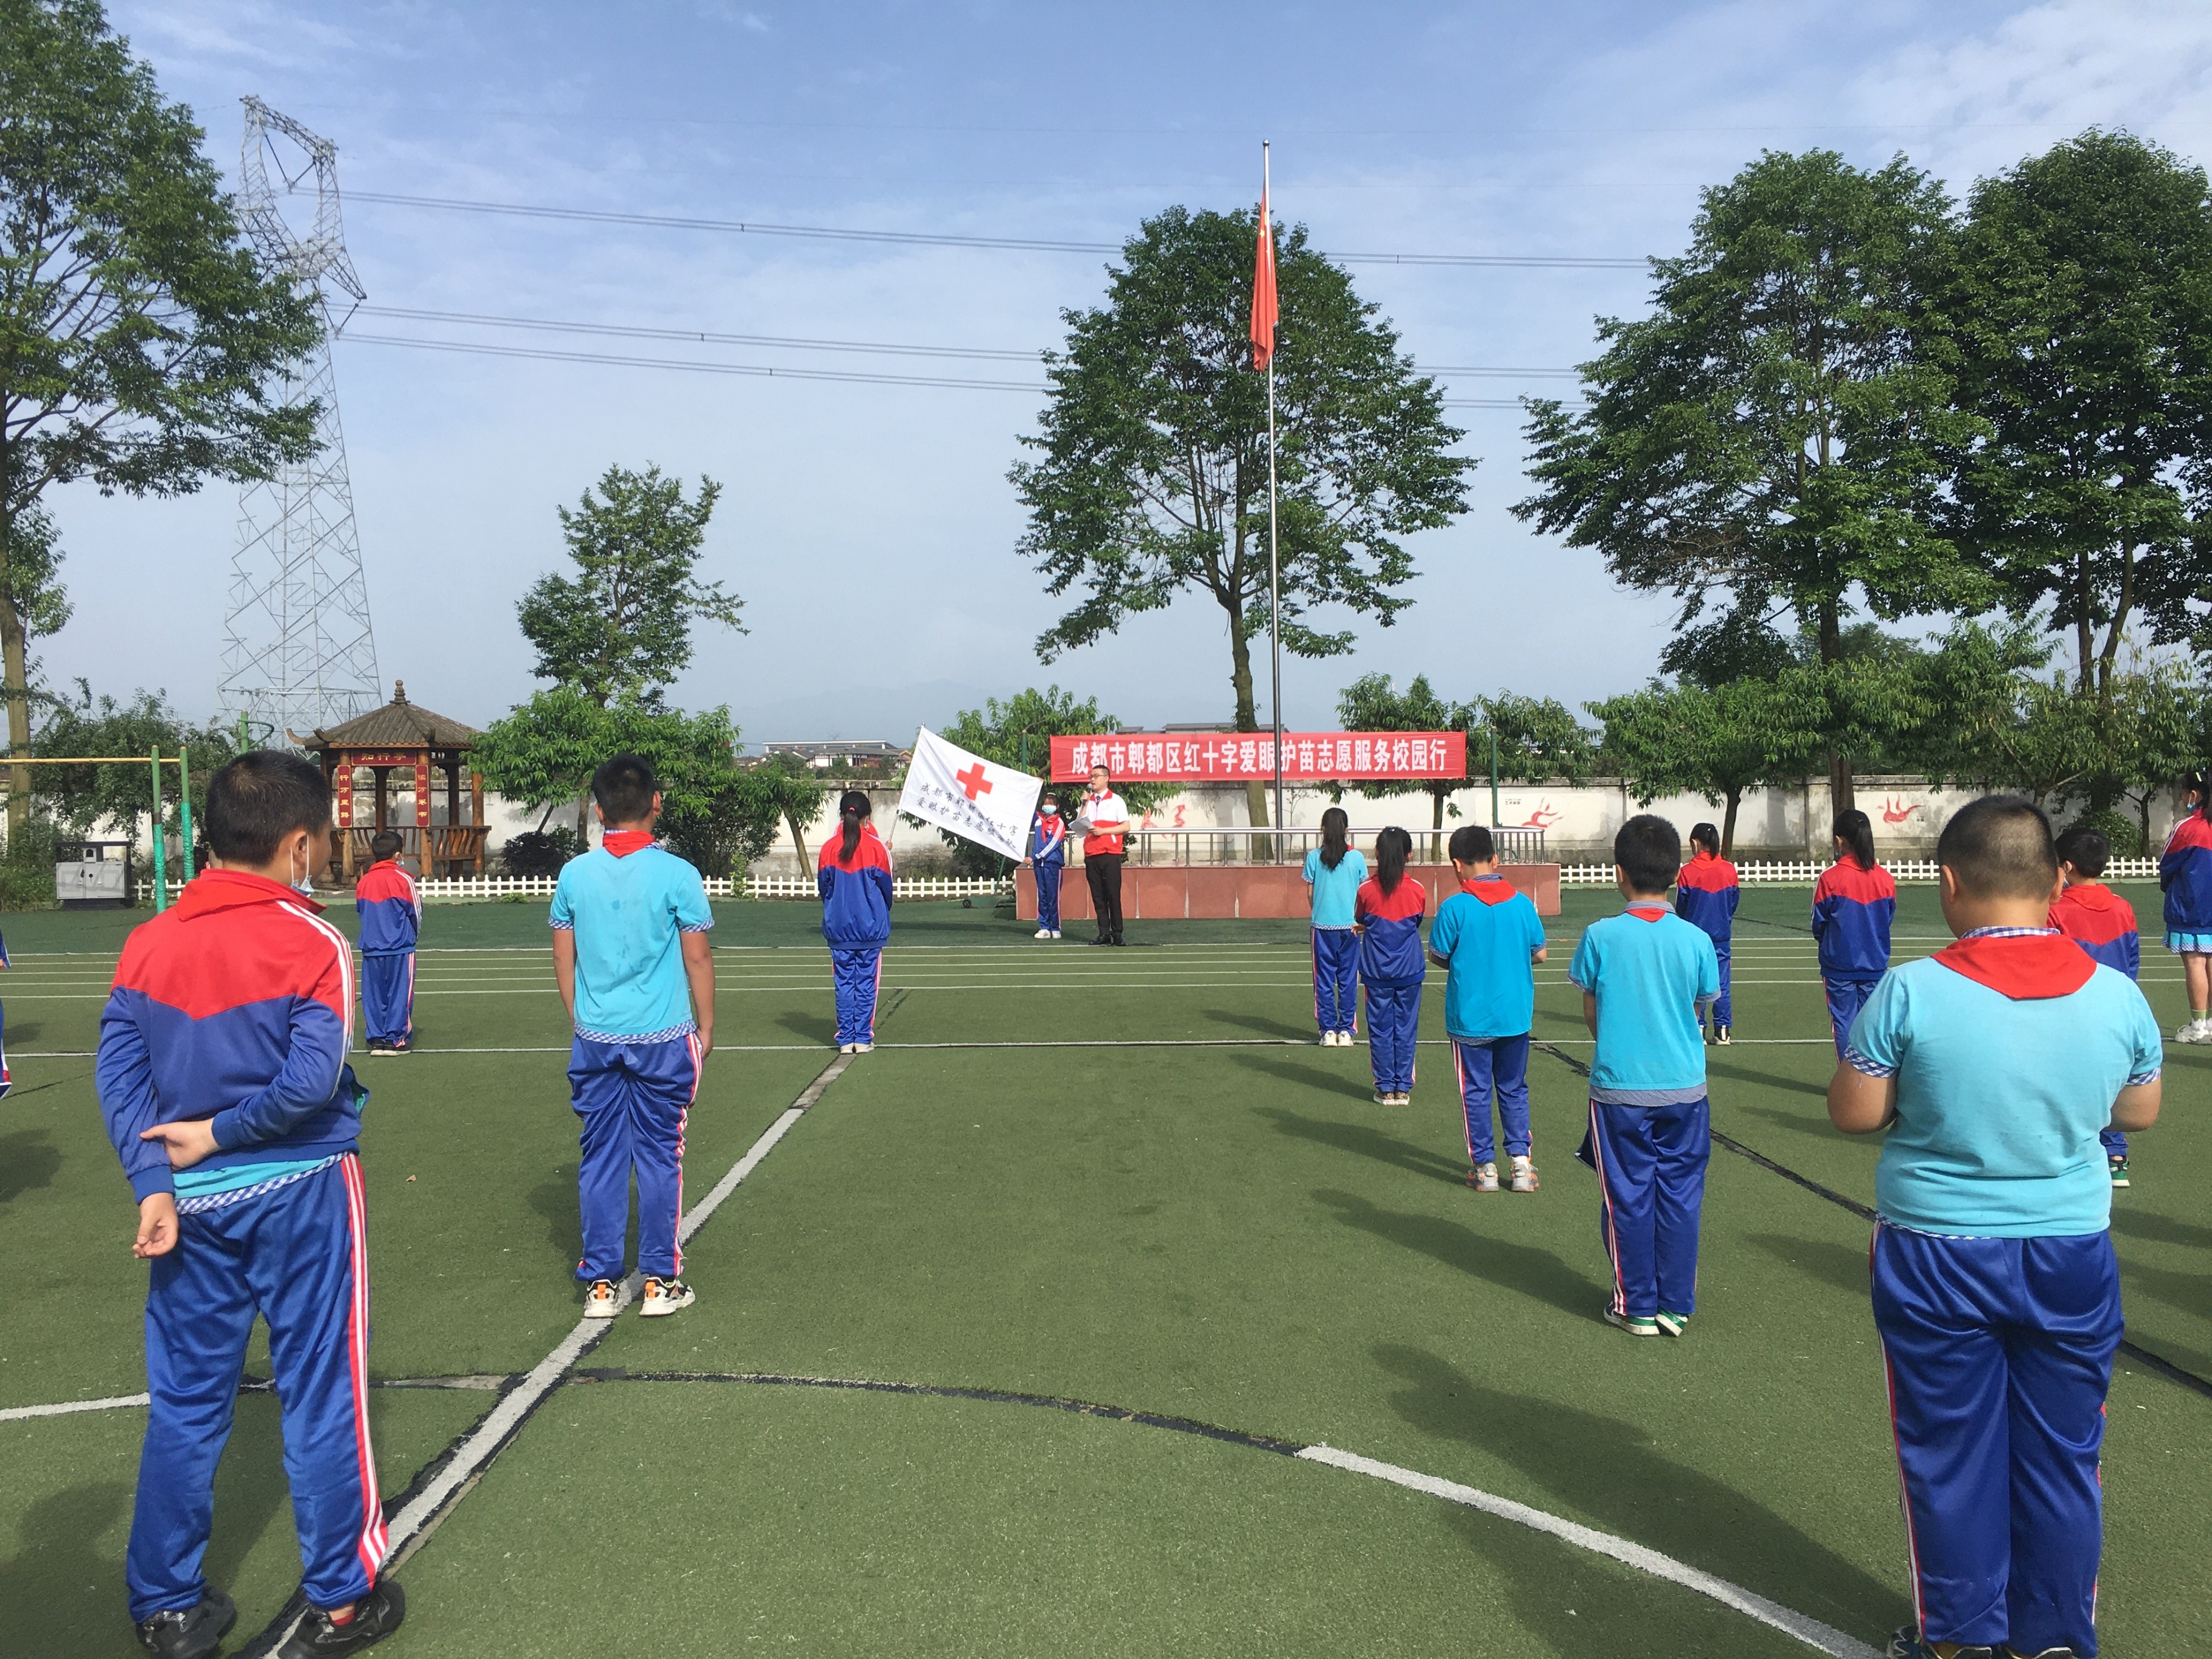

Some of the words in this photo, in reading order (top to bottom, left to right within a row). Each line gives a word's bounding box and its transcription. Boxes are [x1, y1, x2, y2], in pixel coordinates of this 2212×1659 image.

[1071, 738, 1446, 774] 成都市郫都区红十字爱眼护苗志愿服务校园行
[340, 774, 350, 818] 行万里路
